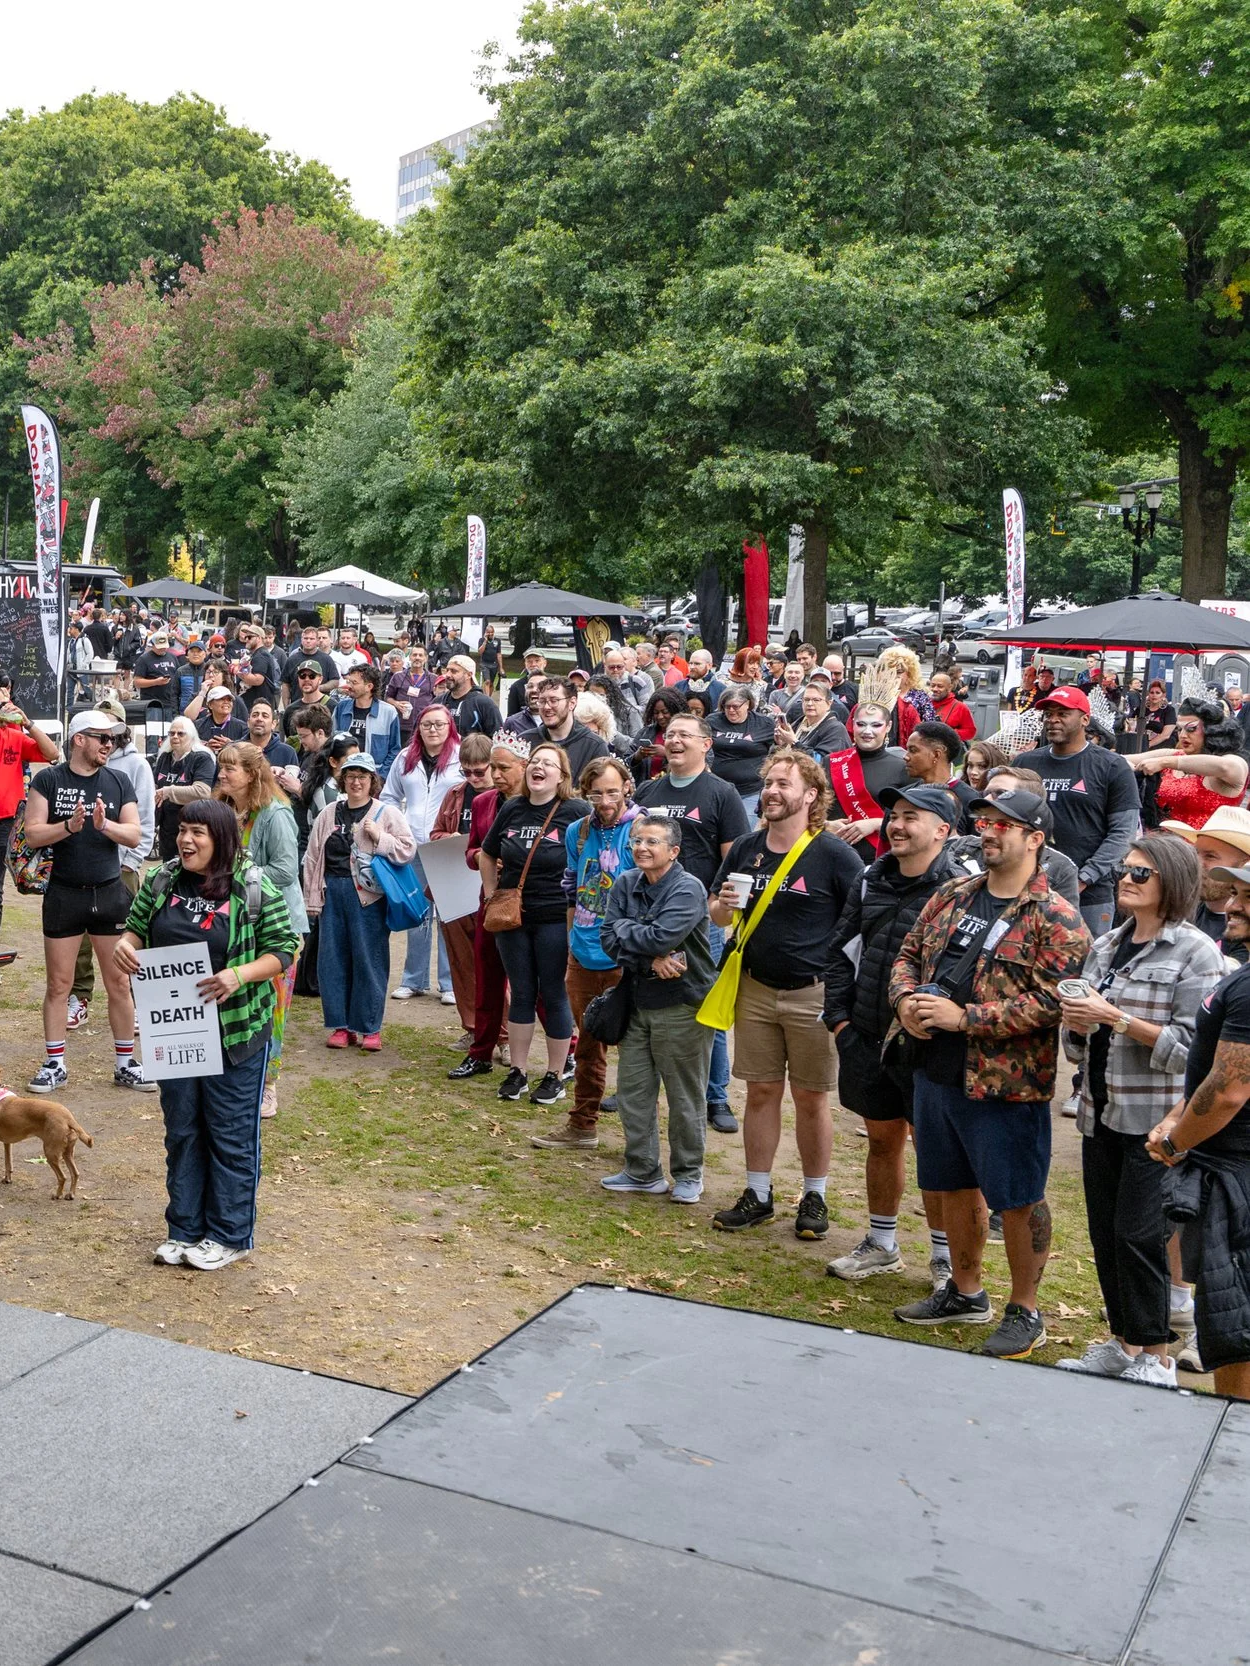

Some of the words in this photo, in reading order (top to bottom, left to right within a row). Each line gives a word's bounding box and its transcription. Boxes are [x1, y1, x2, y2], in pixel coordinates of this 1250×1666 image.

[1207, 606, 1236, 616] IDS
[841, 762, 849, 779] Miss
[845, 782, 855, 796] HIV
[1042, 781, 1070, 790] LIFE
[55, 801, 107, 810] Doxyyclie
[54, 808, 93, 816] Jynns.
[667, 809, 685, 818] IFE
[519, 829, 544, 838] LIF
[754, 879, 788, 891] LIE
[185, 900, 215, 912] LIFE
[137, 960, 206, 981] SILENCE
[170, 990, 179, 998] =
[150, 1005, 205, 1025] DEATH
[168, 1048, 206, 1065] LIFE
